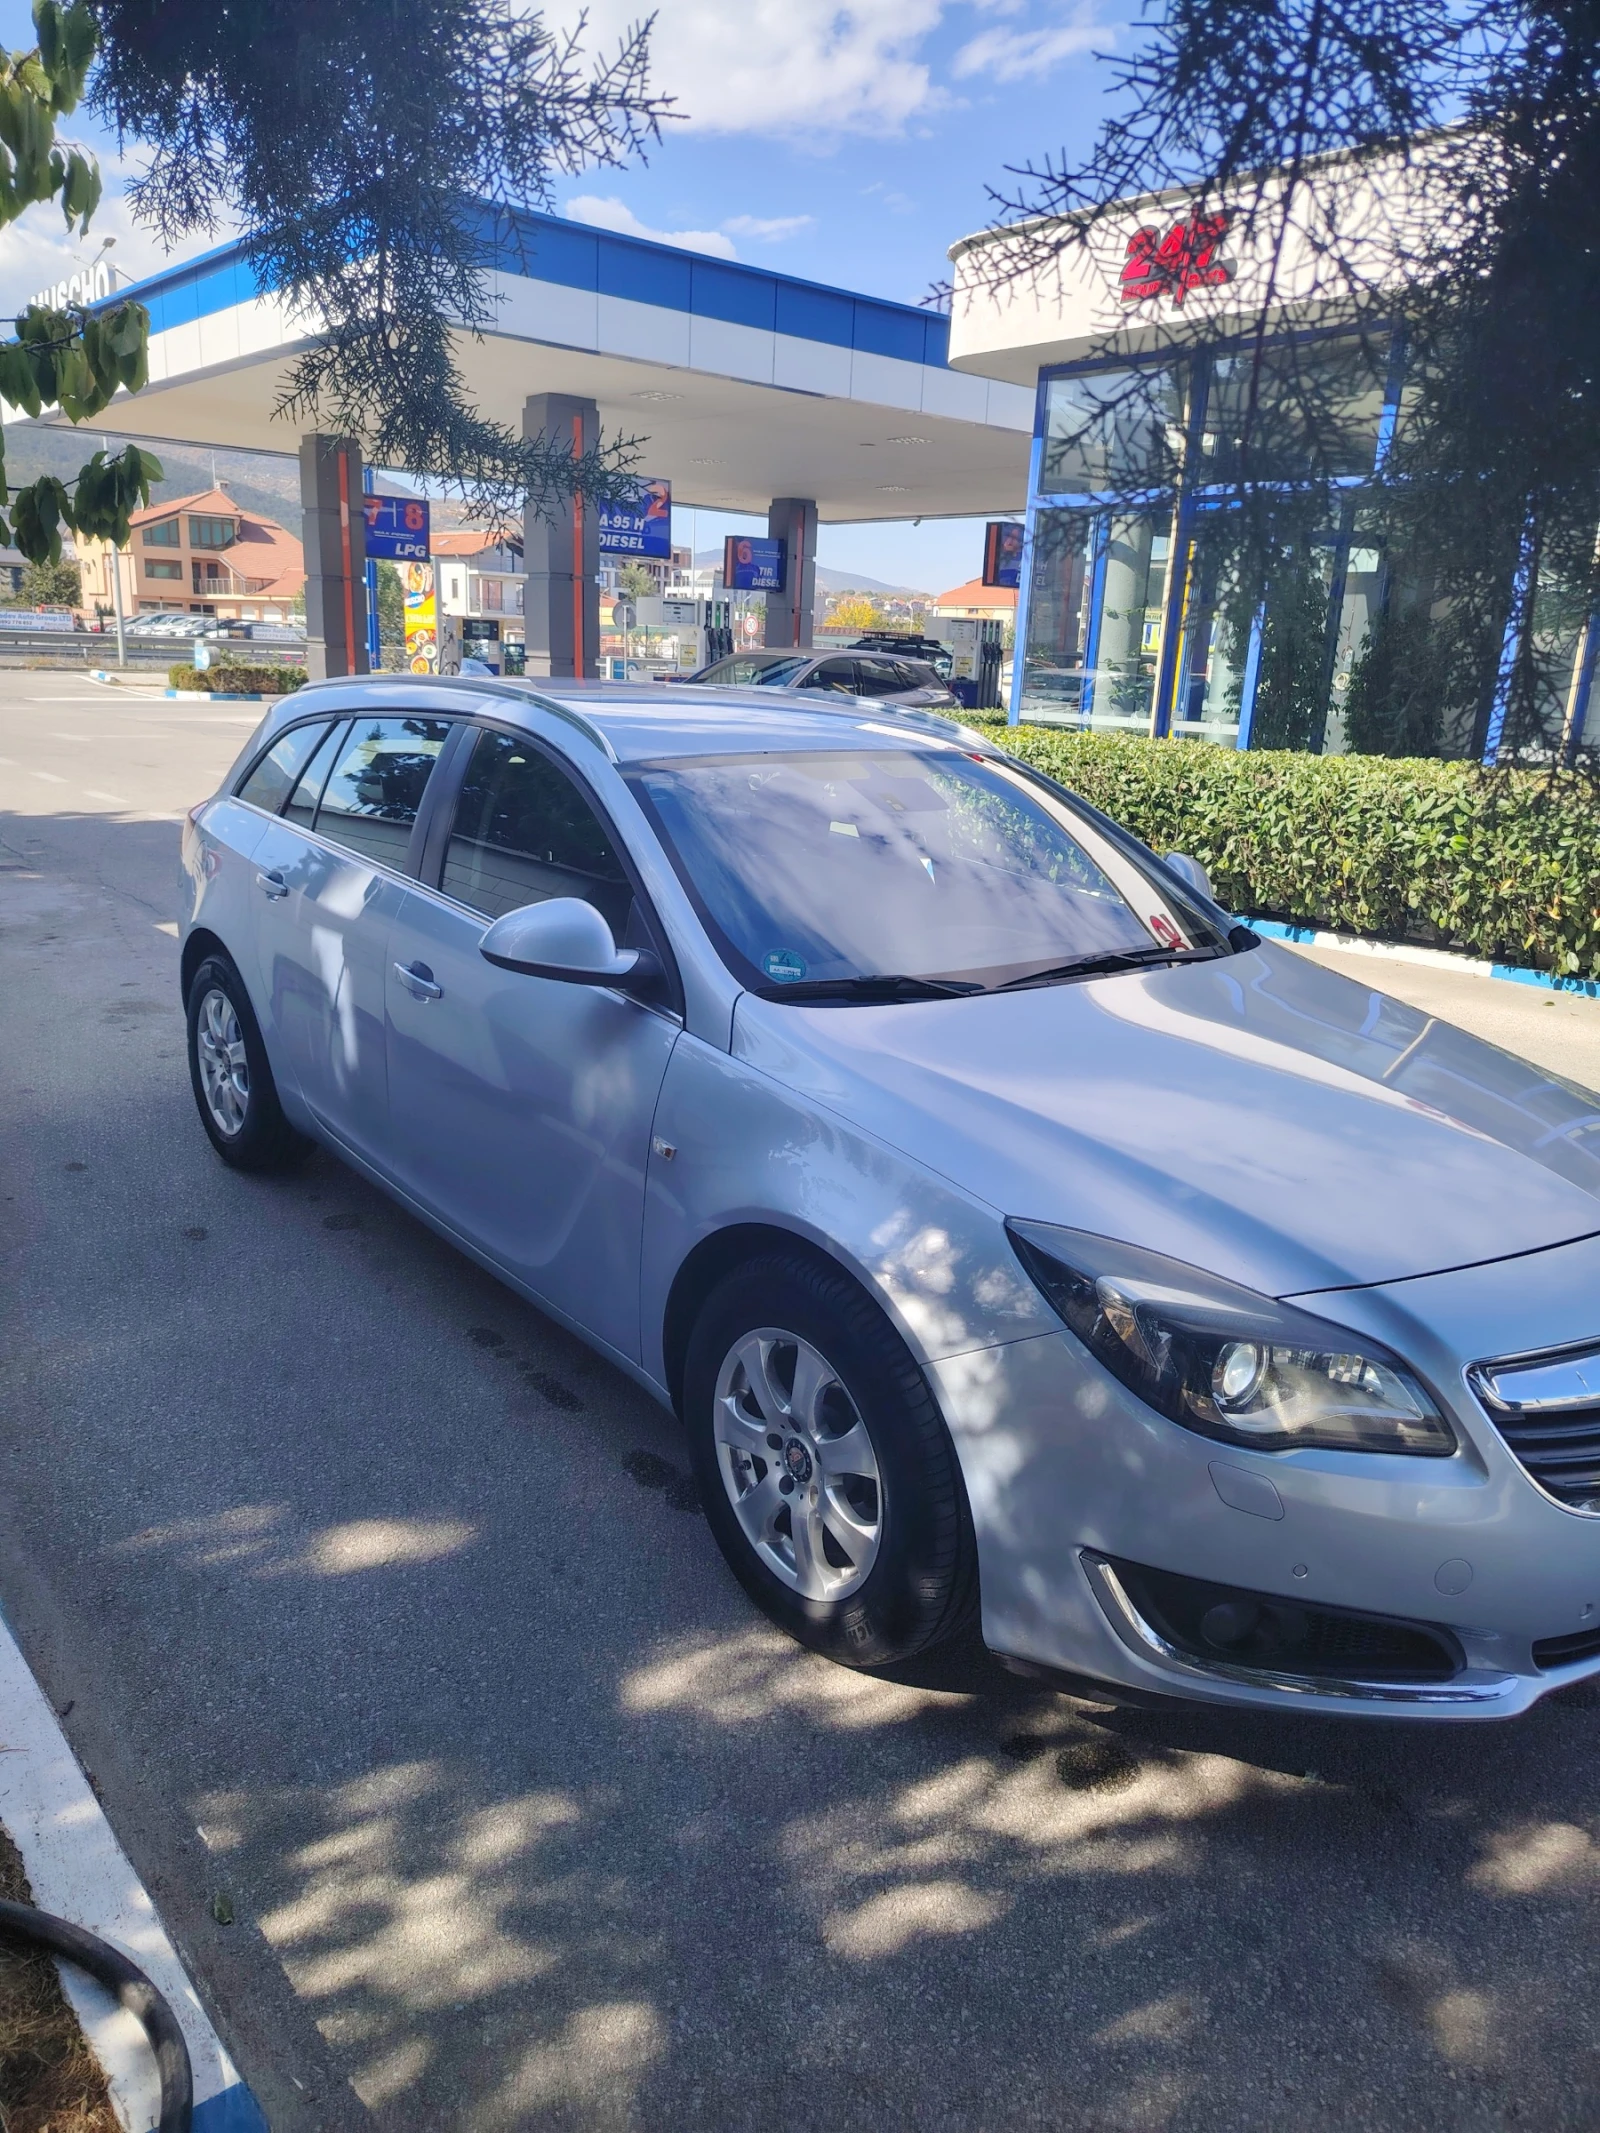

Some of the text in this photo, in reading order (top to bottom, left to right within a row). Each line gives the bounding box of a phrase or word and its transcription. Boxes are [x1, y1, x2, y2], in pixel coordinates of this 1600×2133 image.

[648, 484, 669, 518] 2
[364, 498, 424, 530] 7 8
[599, 513, 630, 530] A-95
[395, 542, 427, 558] LPG
[599, 534, 645, 550] DIESEL
[737, 540, 753, 564] 6
[758, 566, 774, 577] TIR
[752, 577, 781, 588] DIESEL
[36, 614, 57, 622] Group
